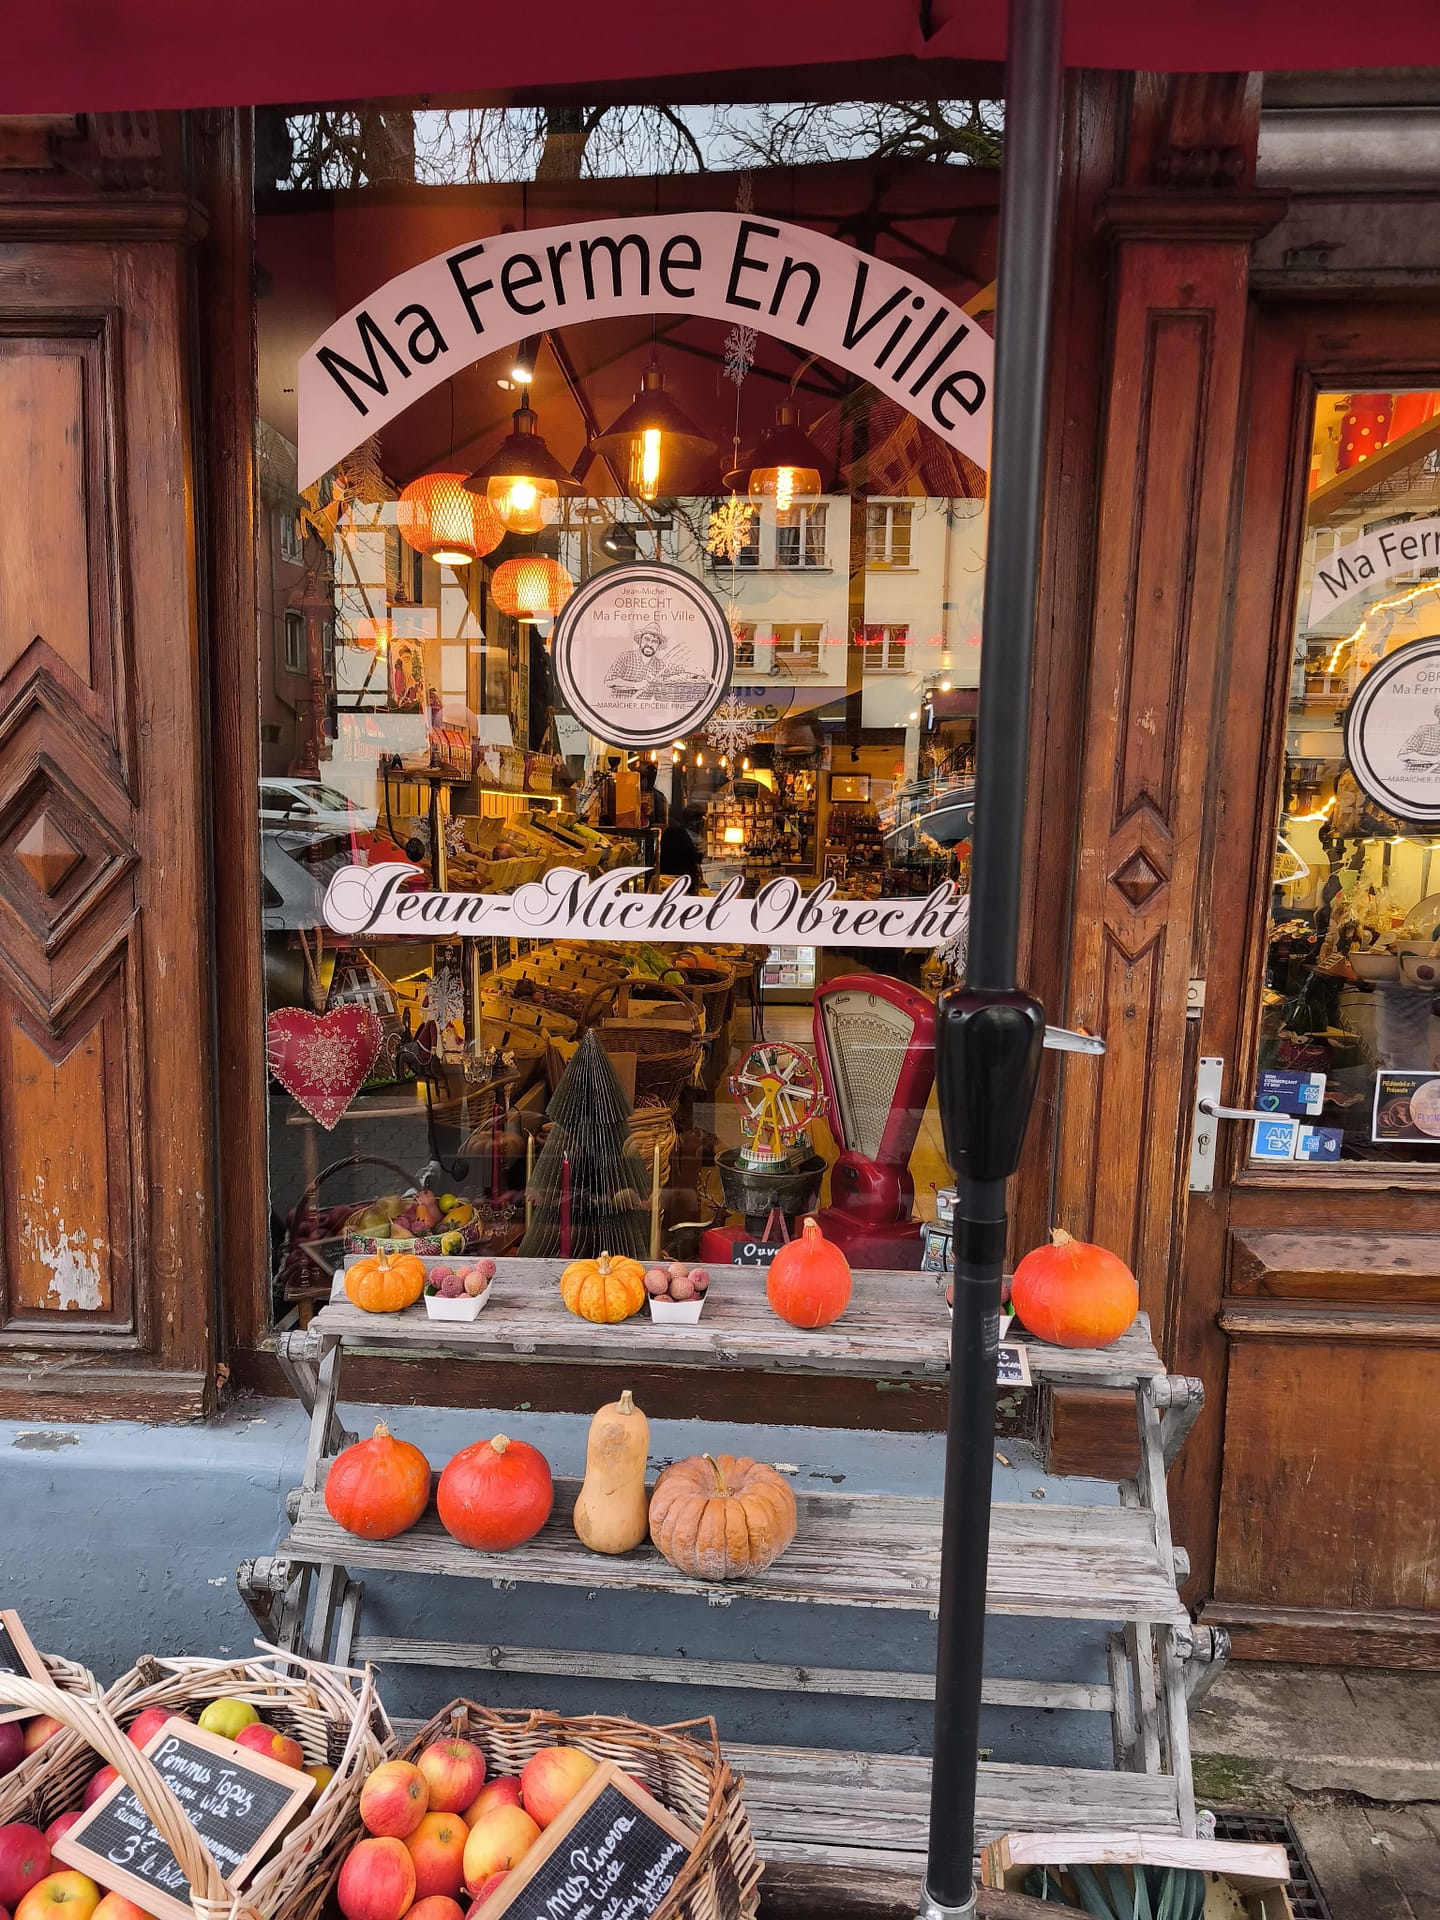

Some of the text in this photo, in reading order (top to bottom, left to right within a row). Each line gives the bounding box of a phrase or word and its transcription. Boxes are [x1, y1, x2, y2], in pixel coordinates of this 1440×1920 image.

[315, 219, 989, 431] Ma Ferme En Ville
[1318, 531, 1440, 599] Ma Fer
[614, 597, 672, 609] OBRECHT
[593, 610, 696, 621] Ma Ferme En Ville
[1392, 684, 1410, 695] Ma
[325, 864, 967, 938] Jean-Michel Obrecht
[1266, 1128, 1292, 1139] AM
[1268, 1139, 1290, 1151] EX
[153, 1738, 211, 1784] Pommes
